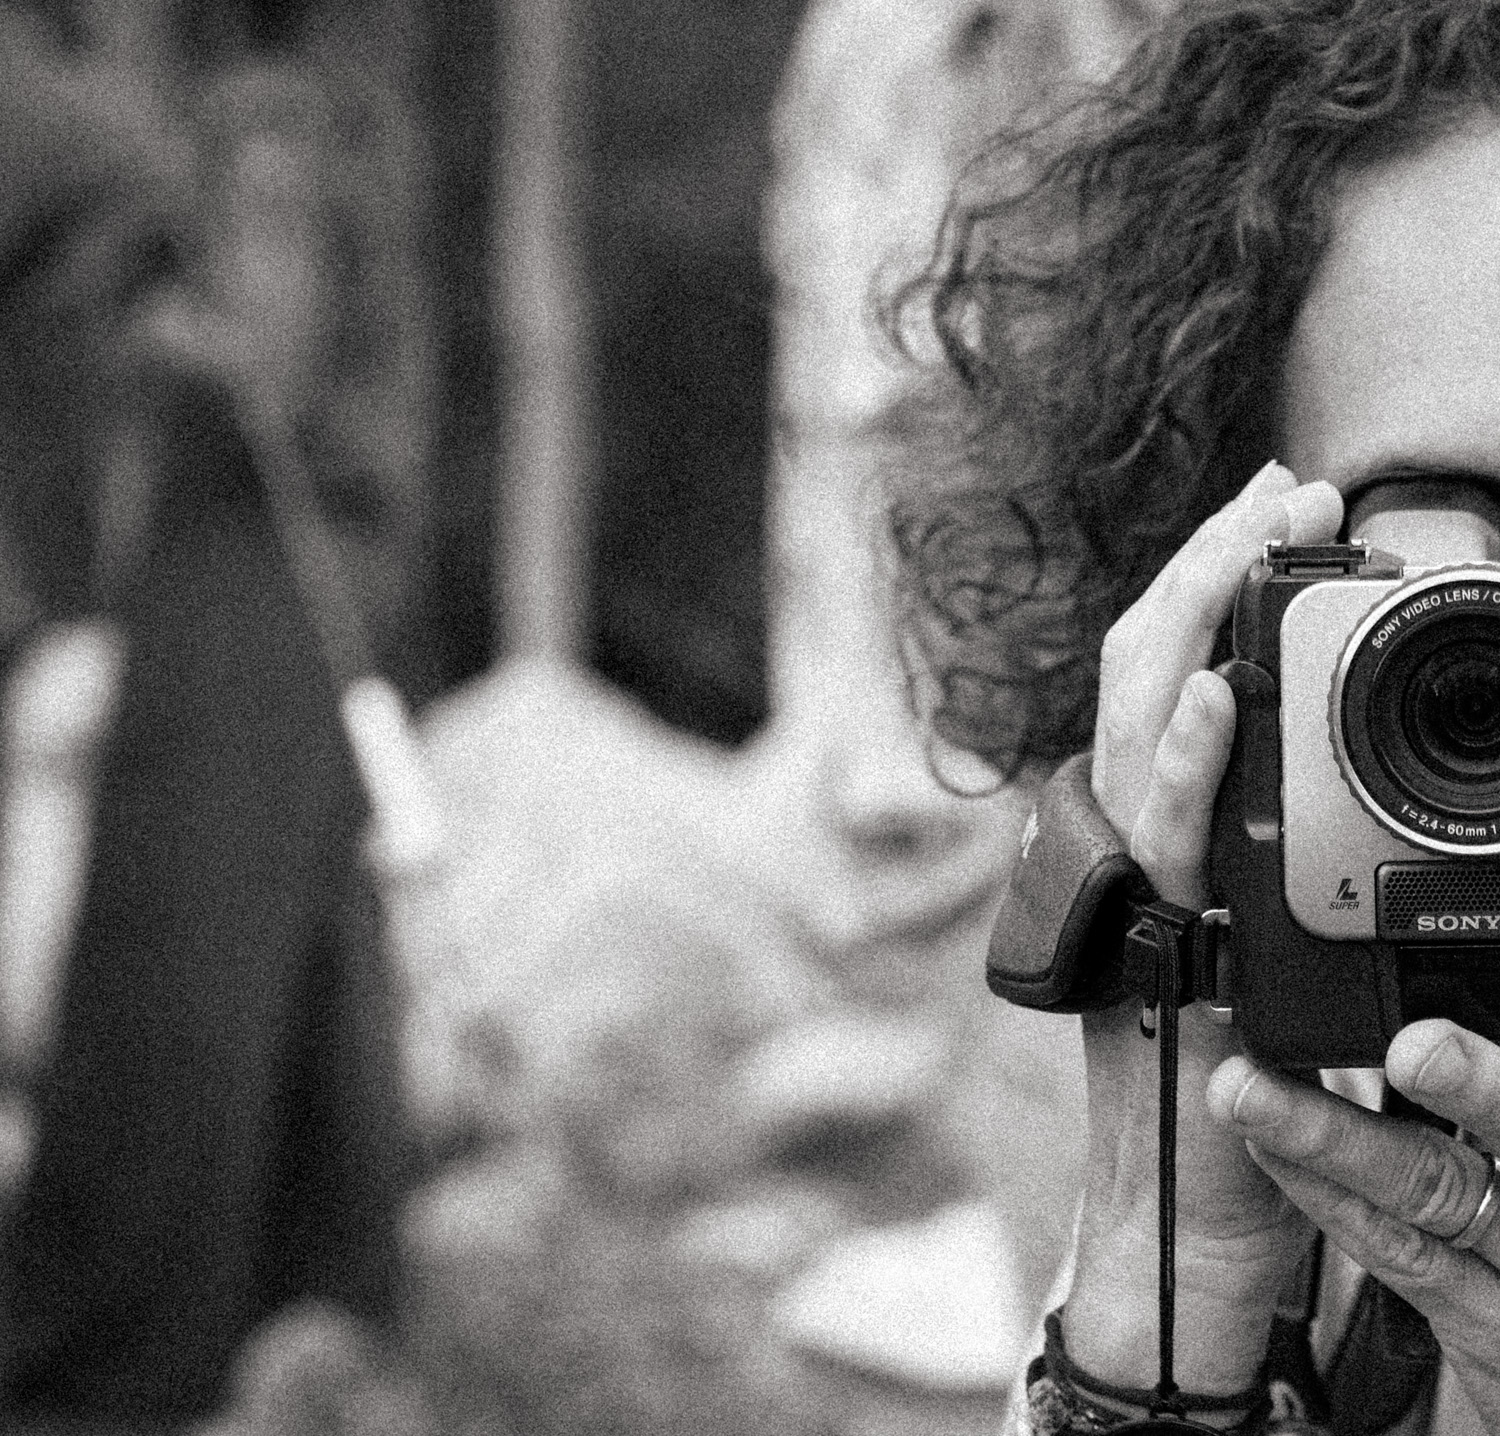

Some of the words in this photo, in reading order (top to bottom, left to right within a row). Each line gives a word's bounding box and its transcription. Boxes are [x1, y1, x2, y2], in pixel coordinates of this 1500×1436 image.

[1372, 616, 1401, 648] SONY
[1401, 595, 1441, 620] VIDEO
[1444, 589, 1480, 603] LENS
[1328, 901, 1360, 910] SUPER
